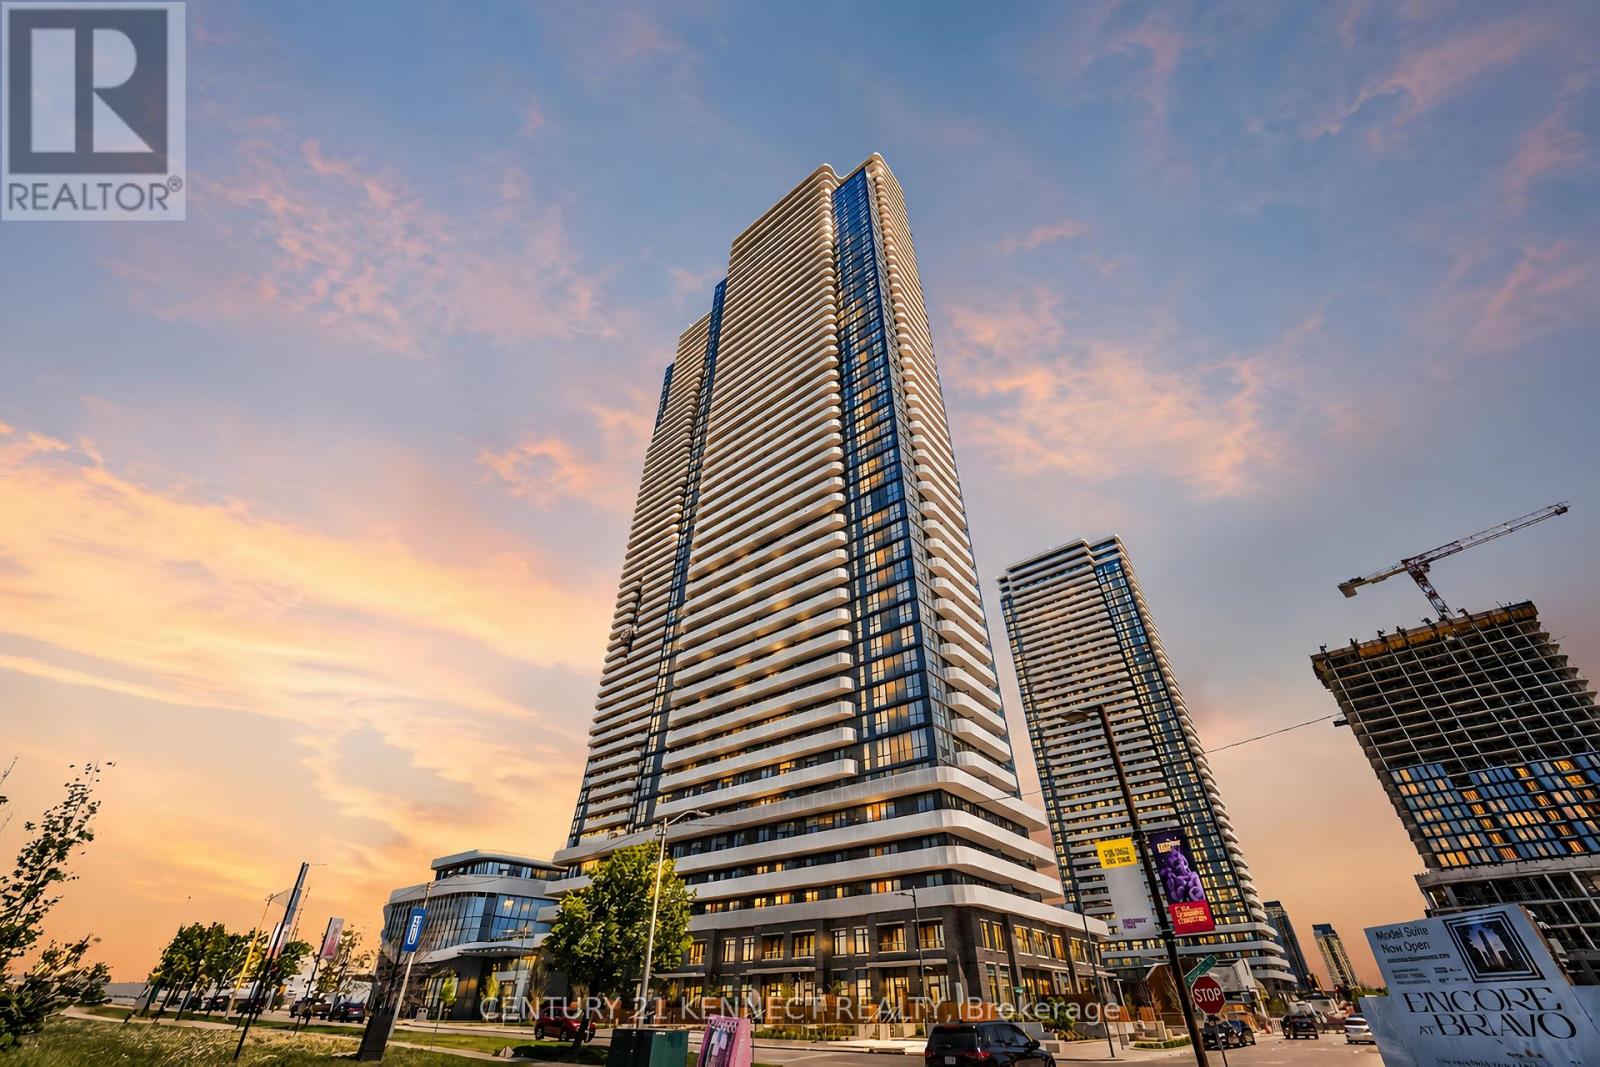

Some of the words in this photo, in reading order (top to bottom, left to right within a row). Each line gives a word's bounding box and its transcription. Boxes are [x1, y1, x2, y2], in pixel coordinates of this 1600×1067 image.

[1375, 929, 1403, 940] Model
[1404, 926, 1429, 937] Suite
[1404, 941, 1431, 953] Open
[1194, 987, 1220, 1003] STOP
[1402, 986, 1562, 1013] ENCORE
[1419, 1024, 1435, 1036] AT
[1433, 1012, 1577, 1039] BRAVO
